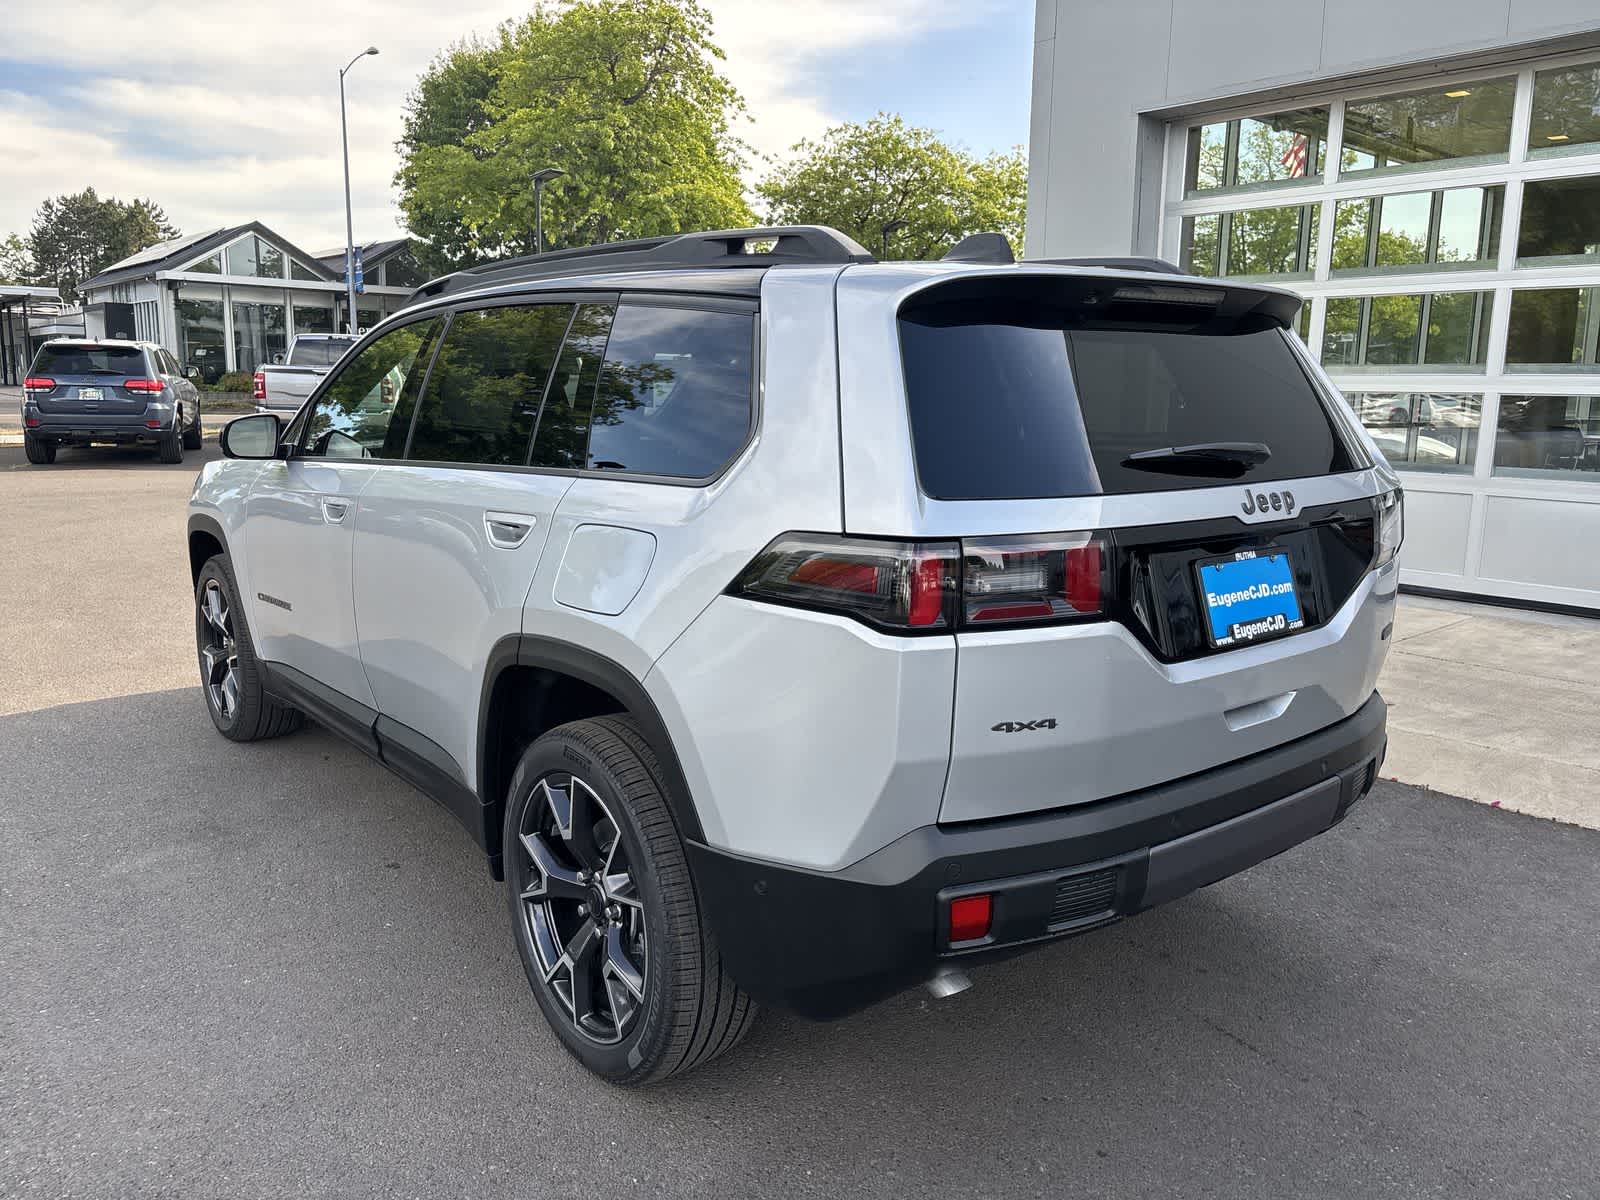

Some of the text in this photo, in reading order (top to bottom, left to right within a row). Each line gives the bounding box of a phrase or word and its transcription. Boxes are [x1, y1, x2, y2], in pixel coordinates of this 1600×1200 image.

[1240, 488, 1296, 516] Jeep
[1207, 582, 1293, 608] EugeneCJD.com
[1233, 614, 1285, 640] EugeneCJD
